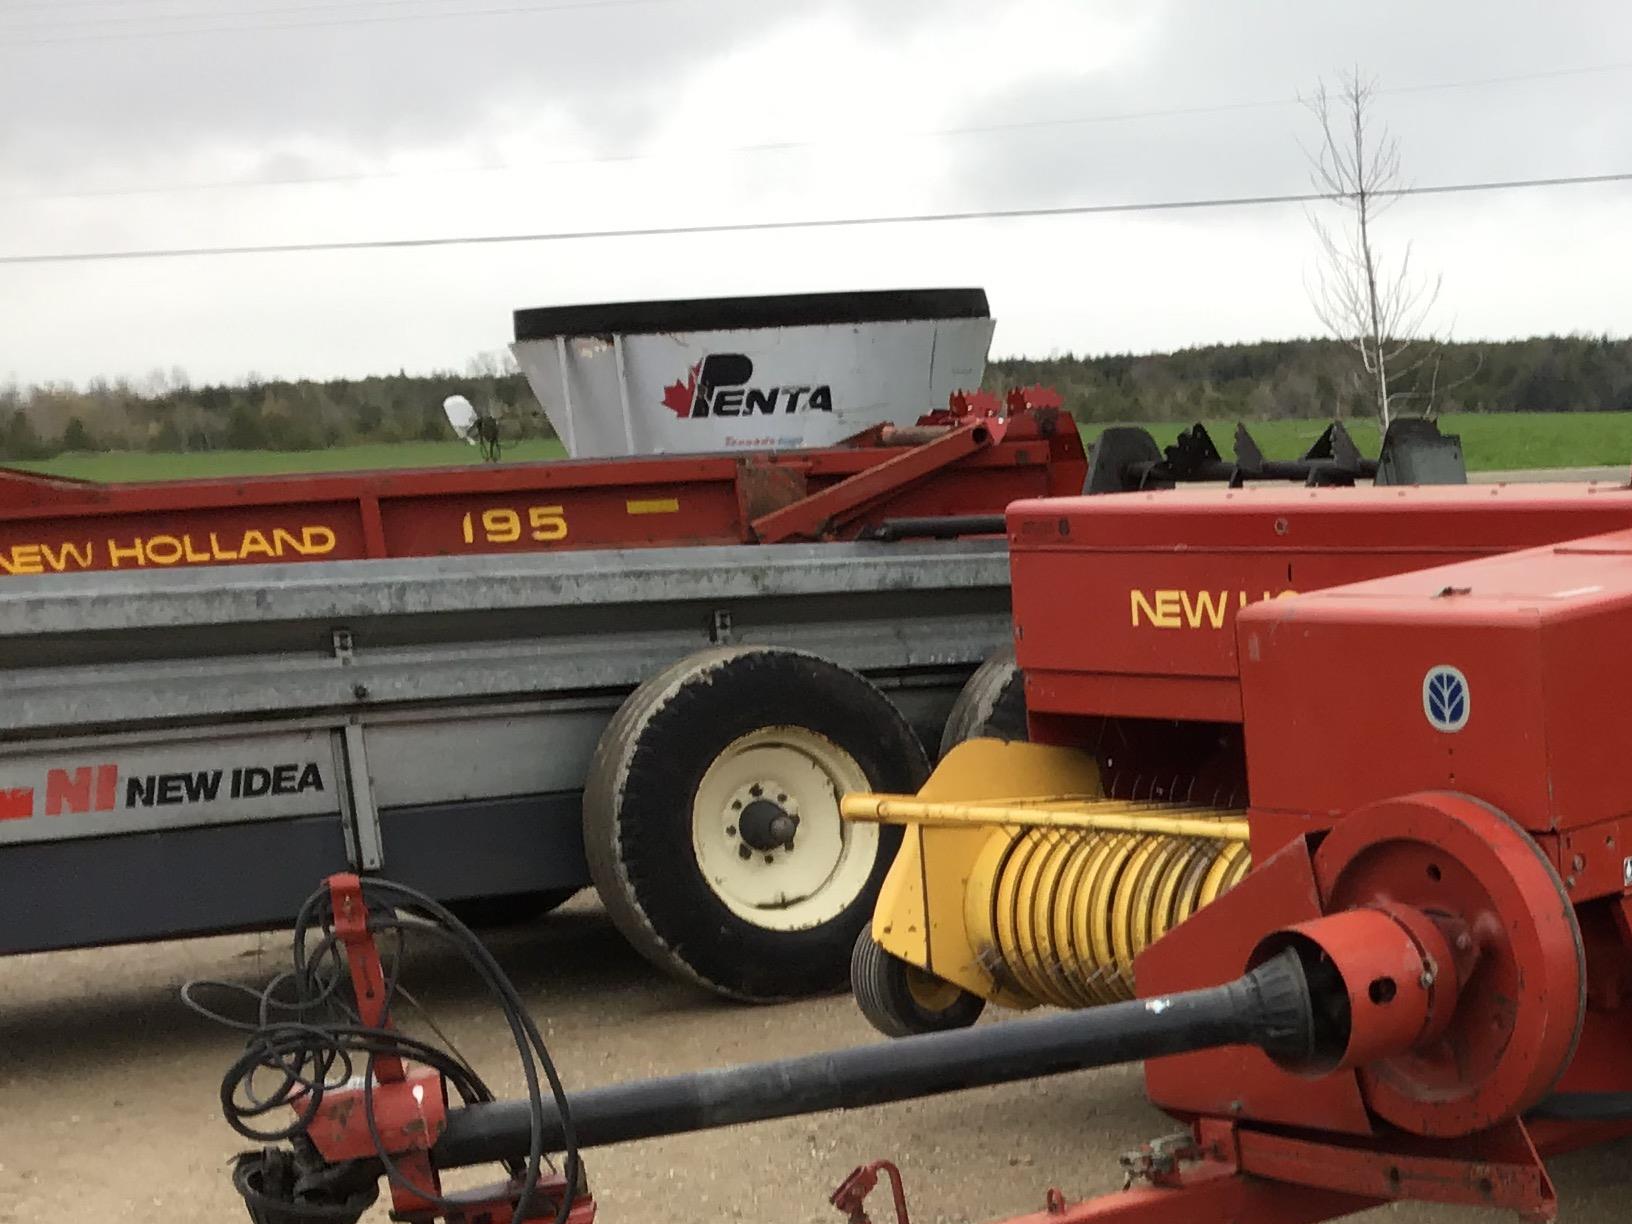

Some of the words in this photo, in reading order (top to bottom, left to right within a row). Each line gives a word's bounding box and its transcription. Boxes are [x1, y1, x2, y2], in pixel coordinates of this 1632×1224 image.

[692, 353, 832, 418] PENTA
[462, 505, 568, 544] 195
[108, 526, 336, 567] HOLLAND
[1130, 589, 1228, 628] NEW
[45, 764, 118, 816] NI
[125, 769, 223, 808] NEW
[230, 762, 325, 799] IDEA
